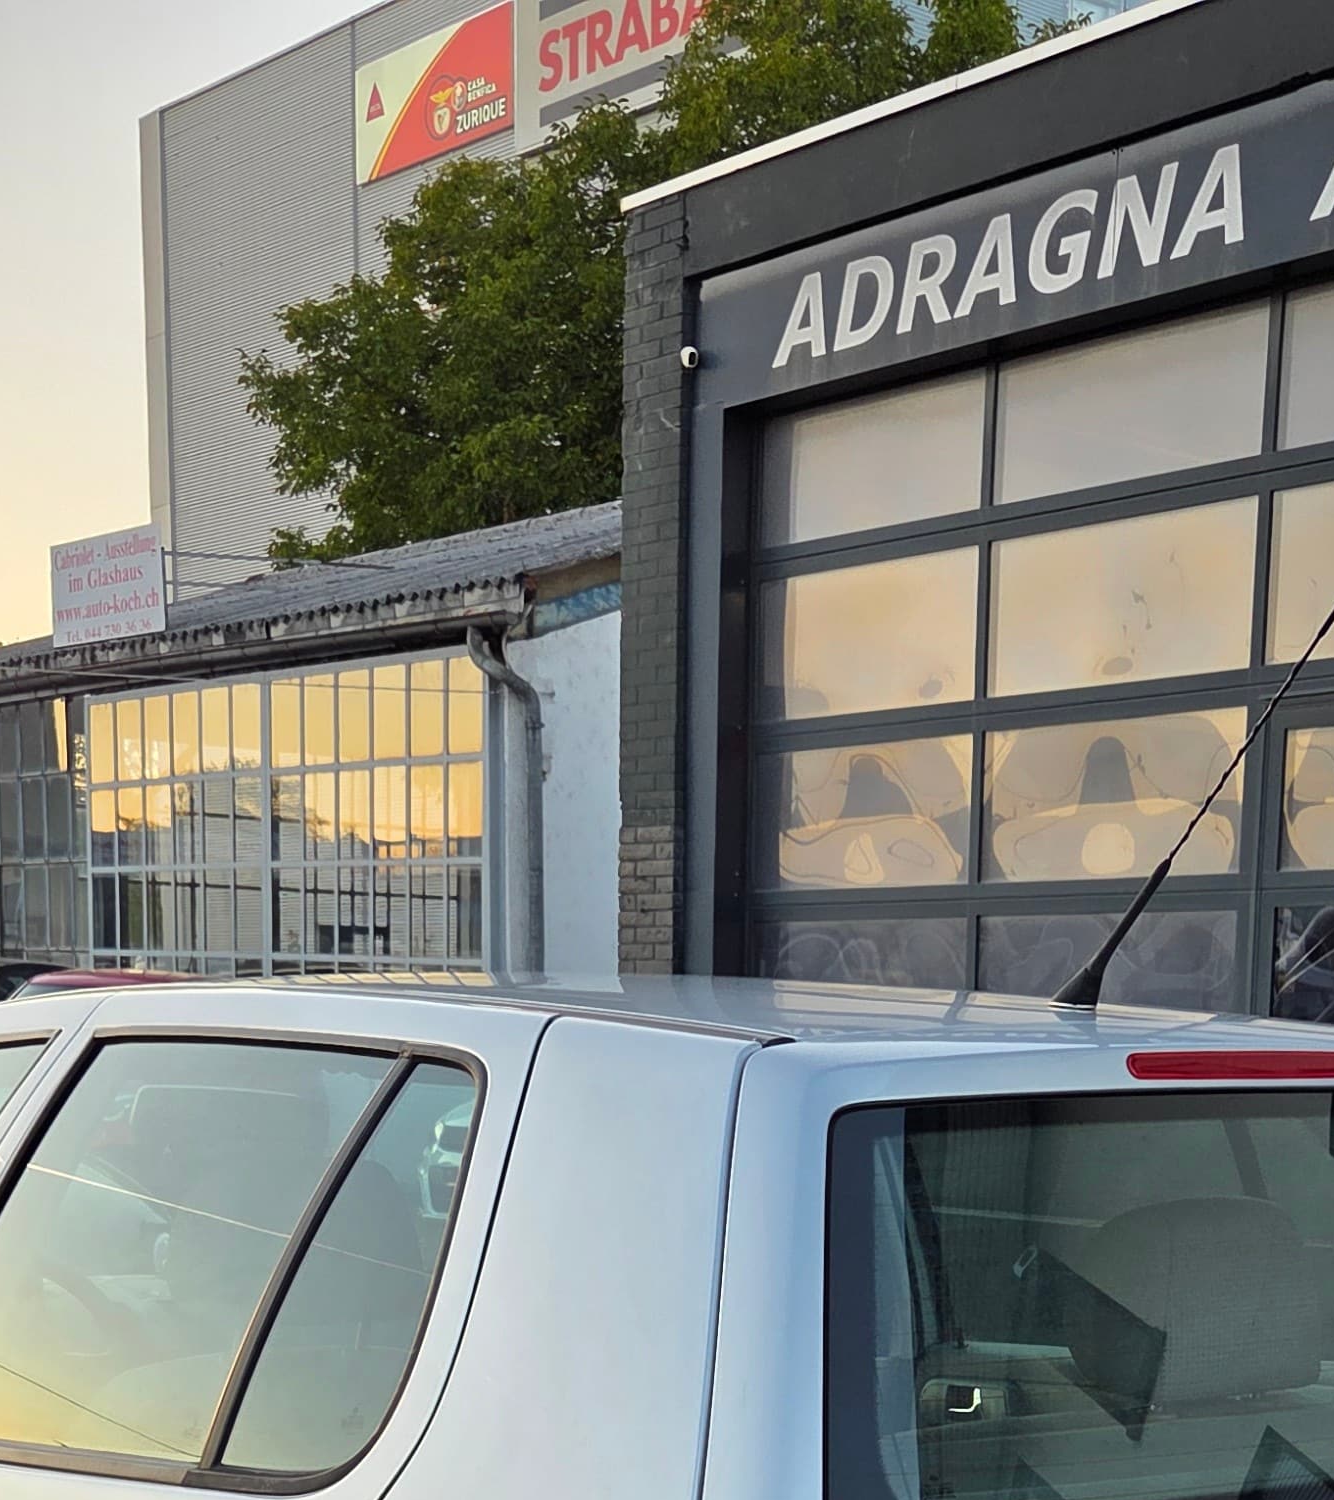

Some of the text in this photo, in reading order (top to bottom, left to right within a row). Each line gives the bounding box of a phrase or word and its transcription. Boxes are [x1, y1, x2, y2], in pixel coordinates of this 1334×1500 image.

[455, 97, 507, 135] ZURIQUE
[771, 143, 1245, 369] ADRAGNA
[68, 564, 144, 593] im Glashaus
[56, 586, 160, 622] www.auto-koch.ch
